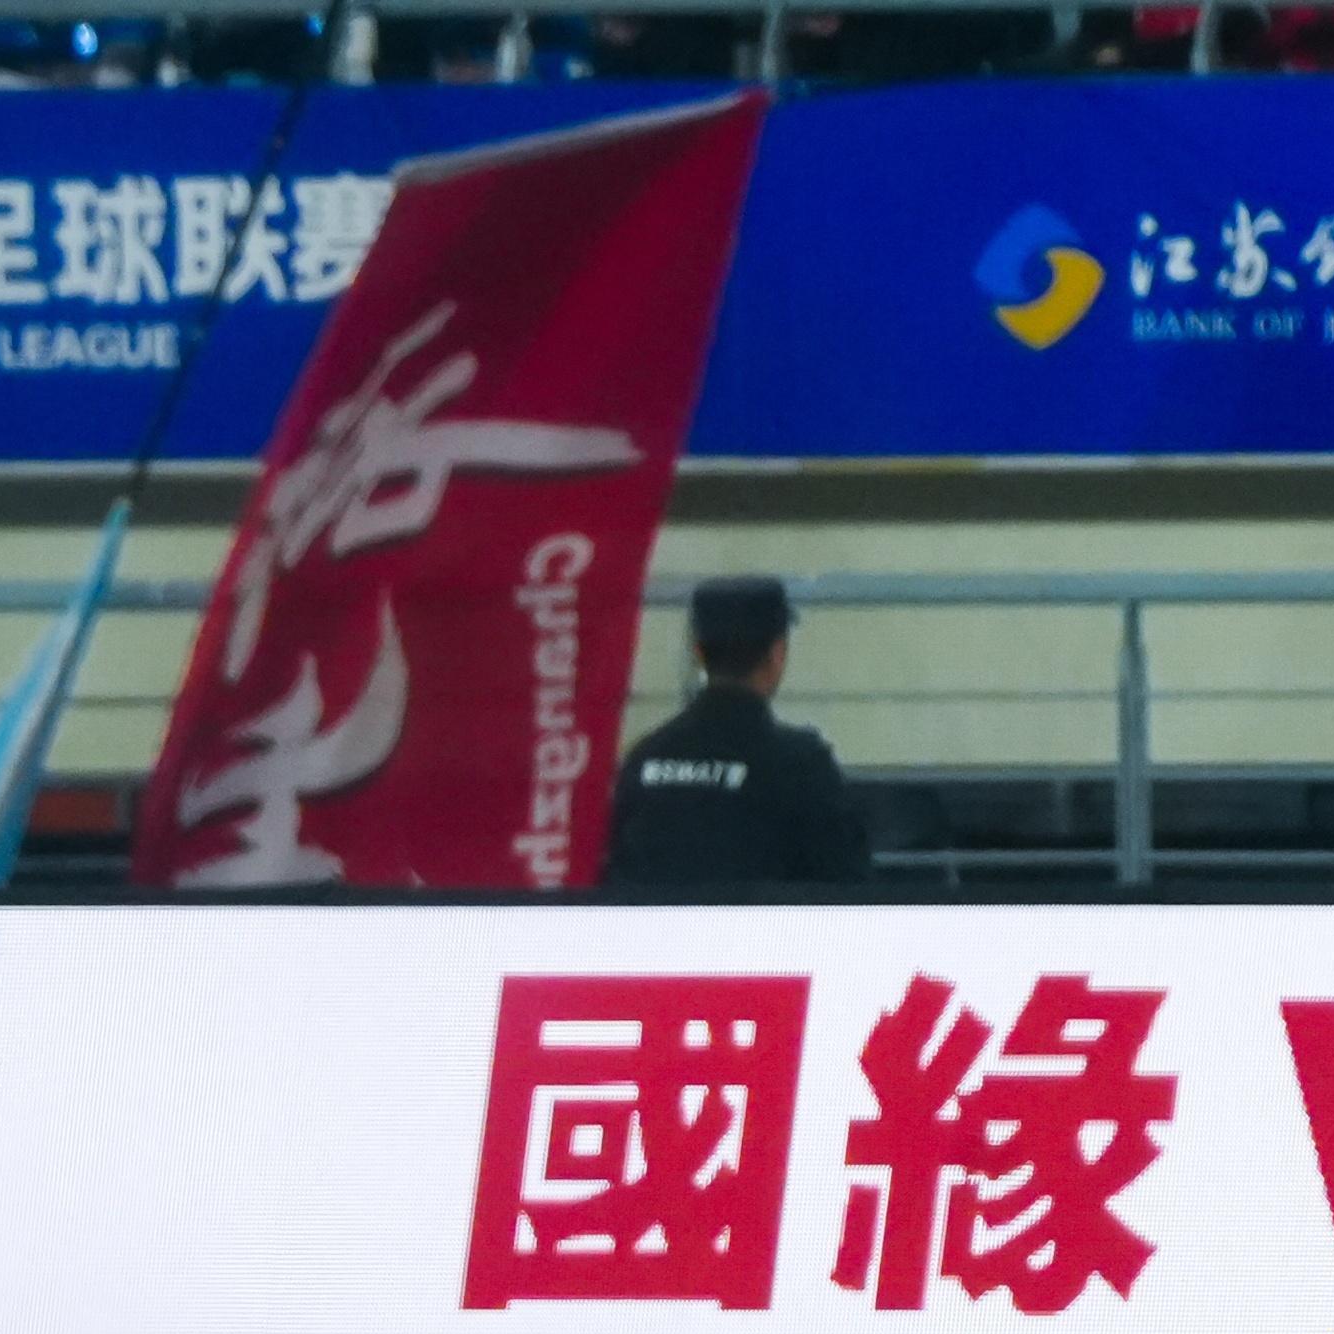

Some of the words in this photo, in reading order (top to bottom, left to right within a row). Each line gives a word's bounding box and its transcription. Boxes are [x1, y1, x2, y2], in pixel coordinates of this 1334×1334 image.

[1132, 307, 1235, 338] BANK
[1254, 307, 1301, 338] OF
[459, 970, 1181, 1314] 國緣
